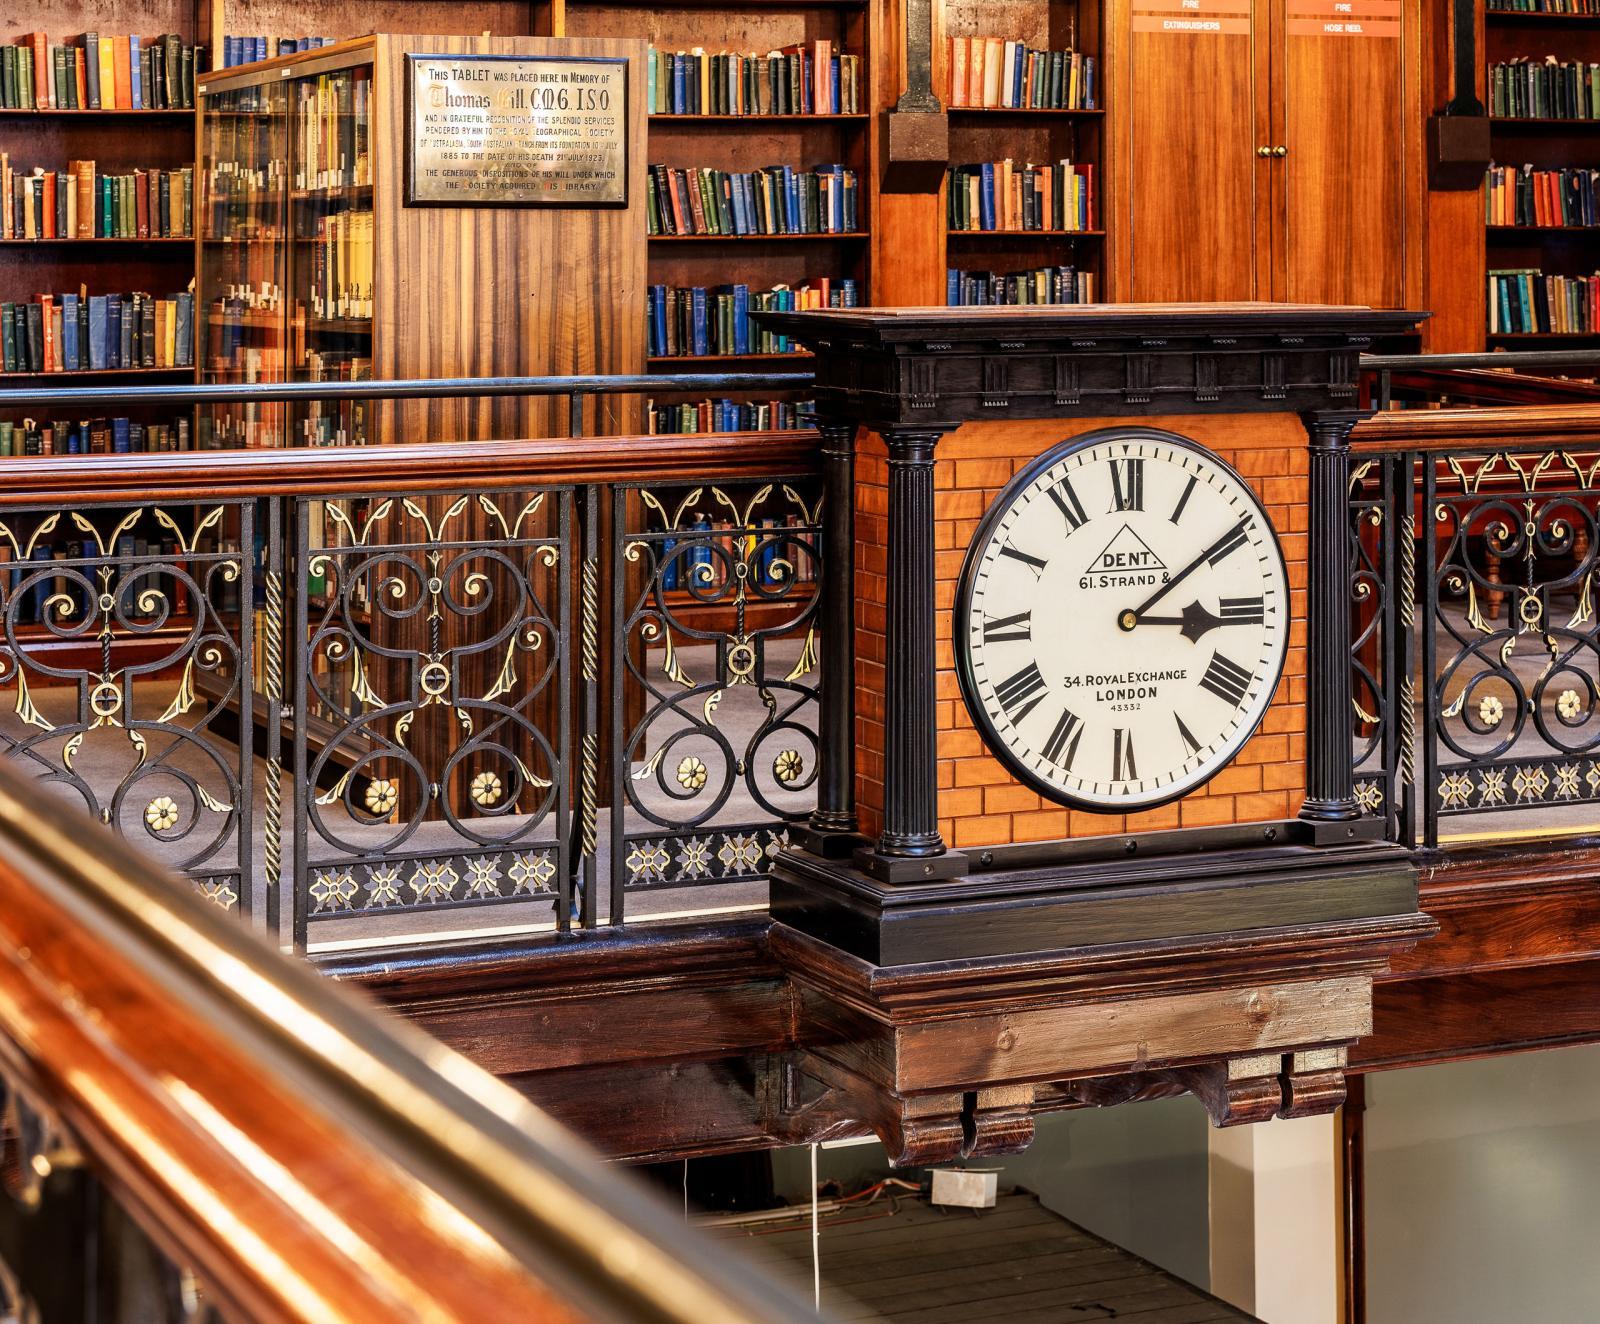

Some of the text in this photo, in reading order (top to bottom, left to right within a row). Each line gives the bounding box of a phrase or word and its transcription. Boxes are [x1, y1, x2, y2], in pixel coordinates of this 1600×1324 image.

[1182, 0, 1200, 9] FIRE
[1335, 3, 1352, 12] FIRE
[1163, 20, 1220, 30] EXTINGUISHERS
[1324, 24, 1363, 33] HOSE REEL
[452, 69, 490, 81] TABLET
[494, 72, 508, 82] WAS
[510, 72, 538, 82] PLACED
[540, 74, 559, 83] HERE
[561, 74, 568, 83] IN
[570, 72, 600, 83] MEMORY
[602, 74, 610, 84] OF
[429, 84, 490, 109] Thomas
[450, 115, 484, 123] GRATEFUL
[538, 116, 549, 124] THE
[552, 116, 581, 124] SPLENDID
[584, 117, 615, 125] SERVICES
[426, 127, 460, 135] RENDERED
[462, 127, 470, 135] BY
[442, 169, 478, 177] GENEROUS
[482, 170, 528, 178] DISPOSITIONS
[499, 182, 536, 190] ACQUIRED
[1103, 551, 1157, 568] DENT.
[1079, 572, 1171, 589] 61. STRAND &
[1096, 686, 1158, 702] LONDON
[1110, 703, 1141, 712] 43332
